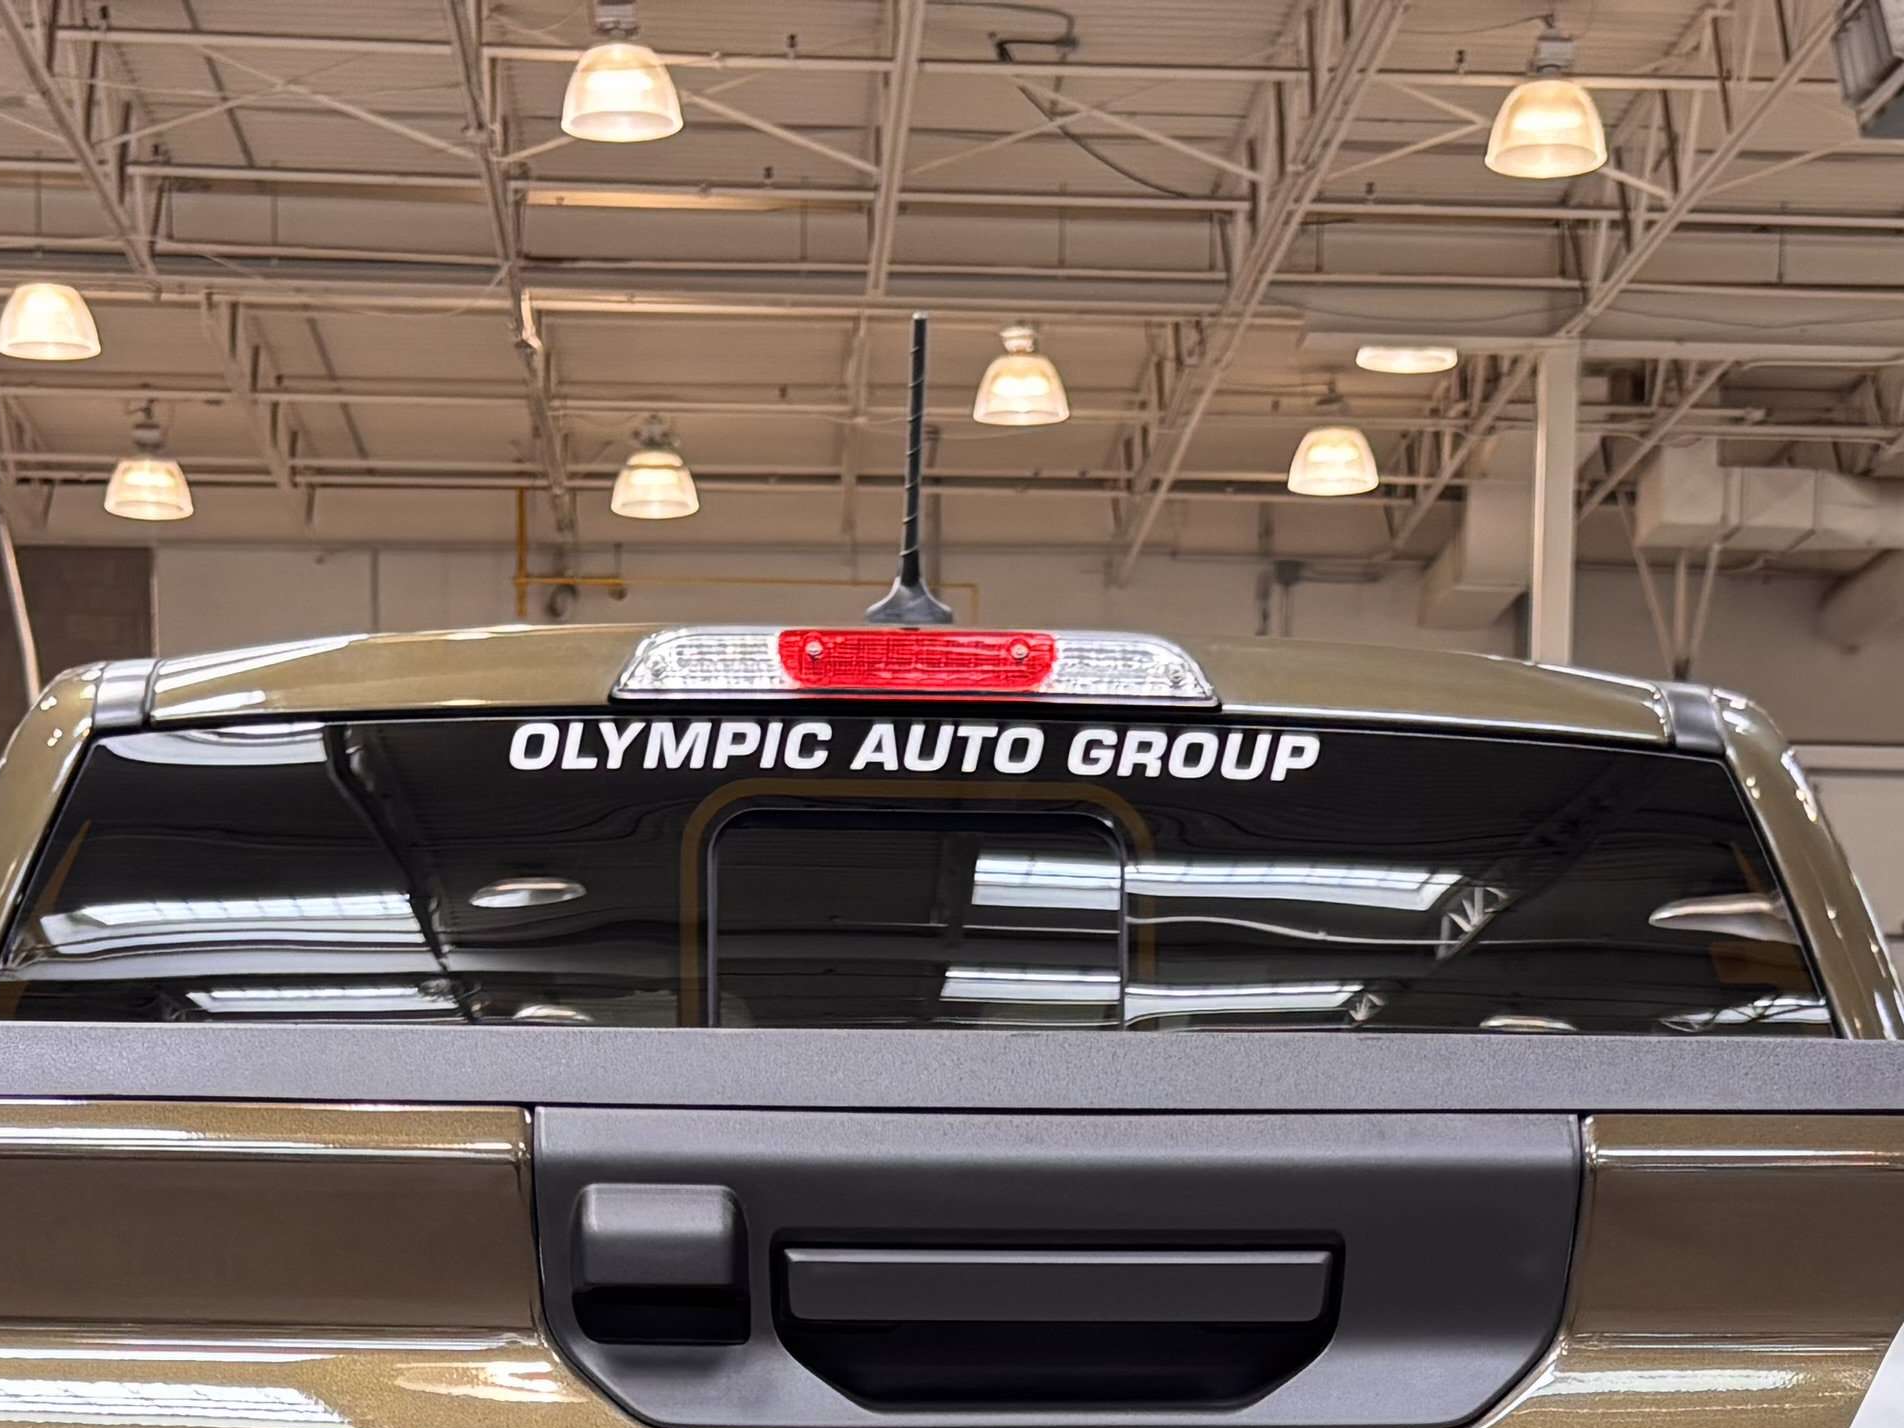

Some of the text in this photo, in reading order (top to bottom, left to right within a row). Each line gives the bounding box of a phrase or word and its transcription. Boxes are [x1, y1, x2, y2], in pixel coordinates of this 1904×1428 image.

[508, 721, 1322, 782] OLYMPIC AUTO GROUP
